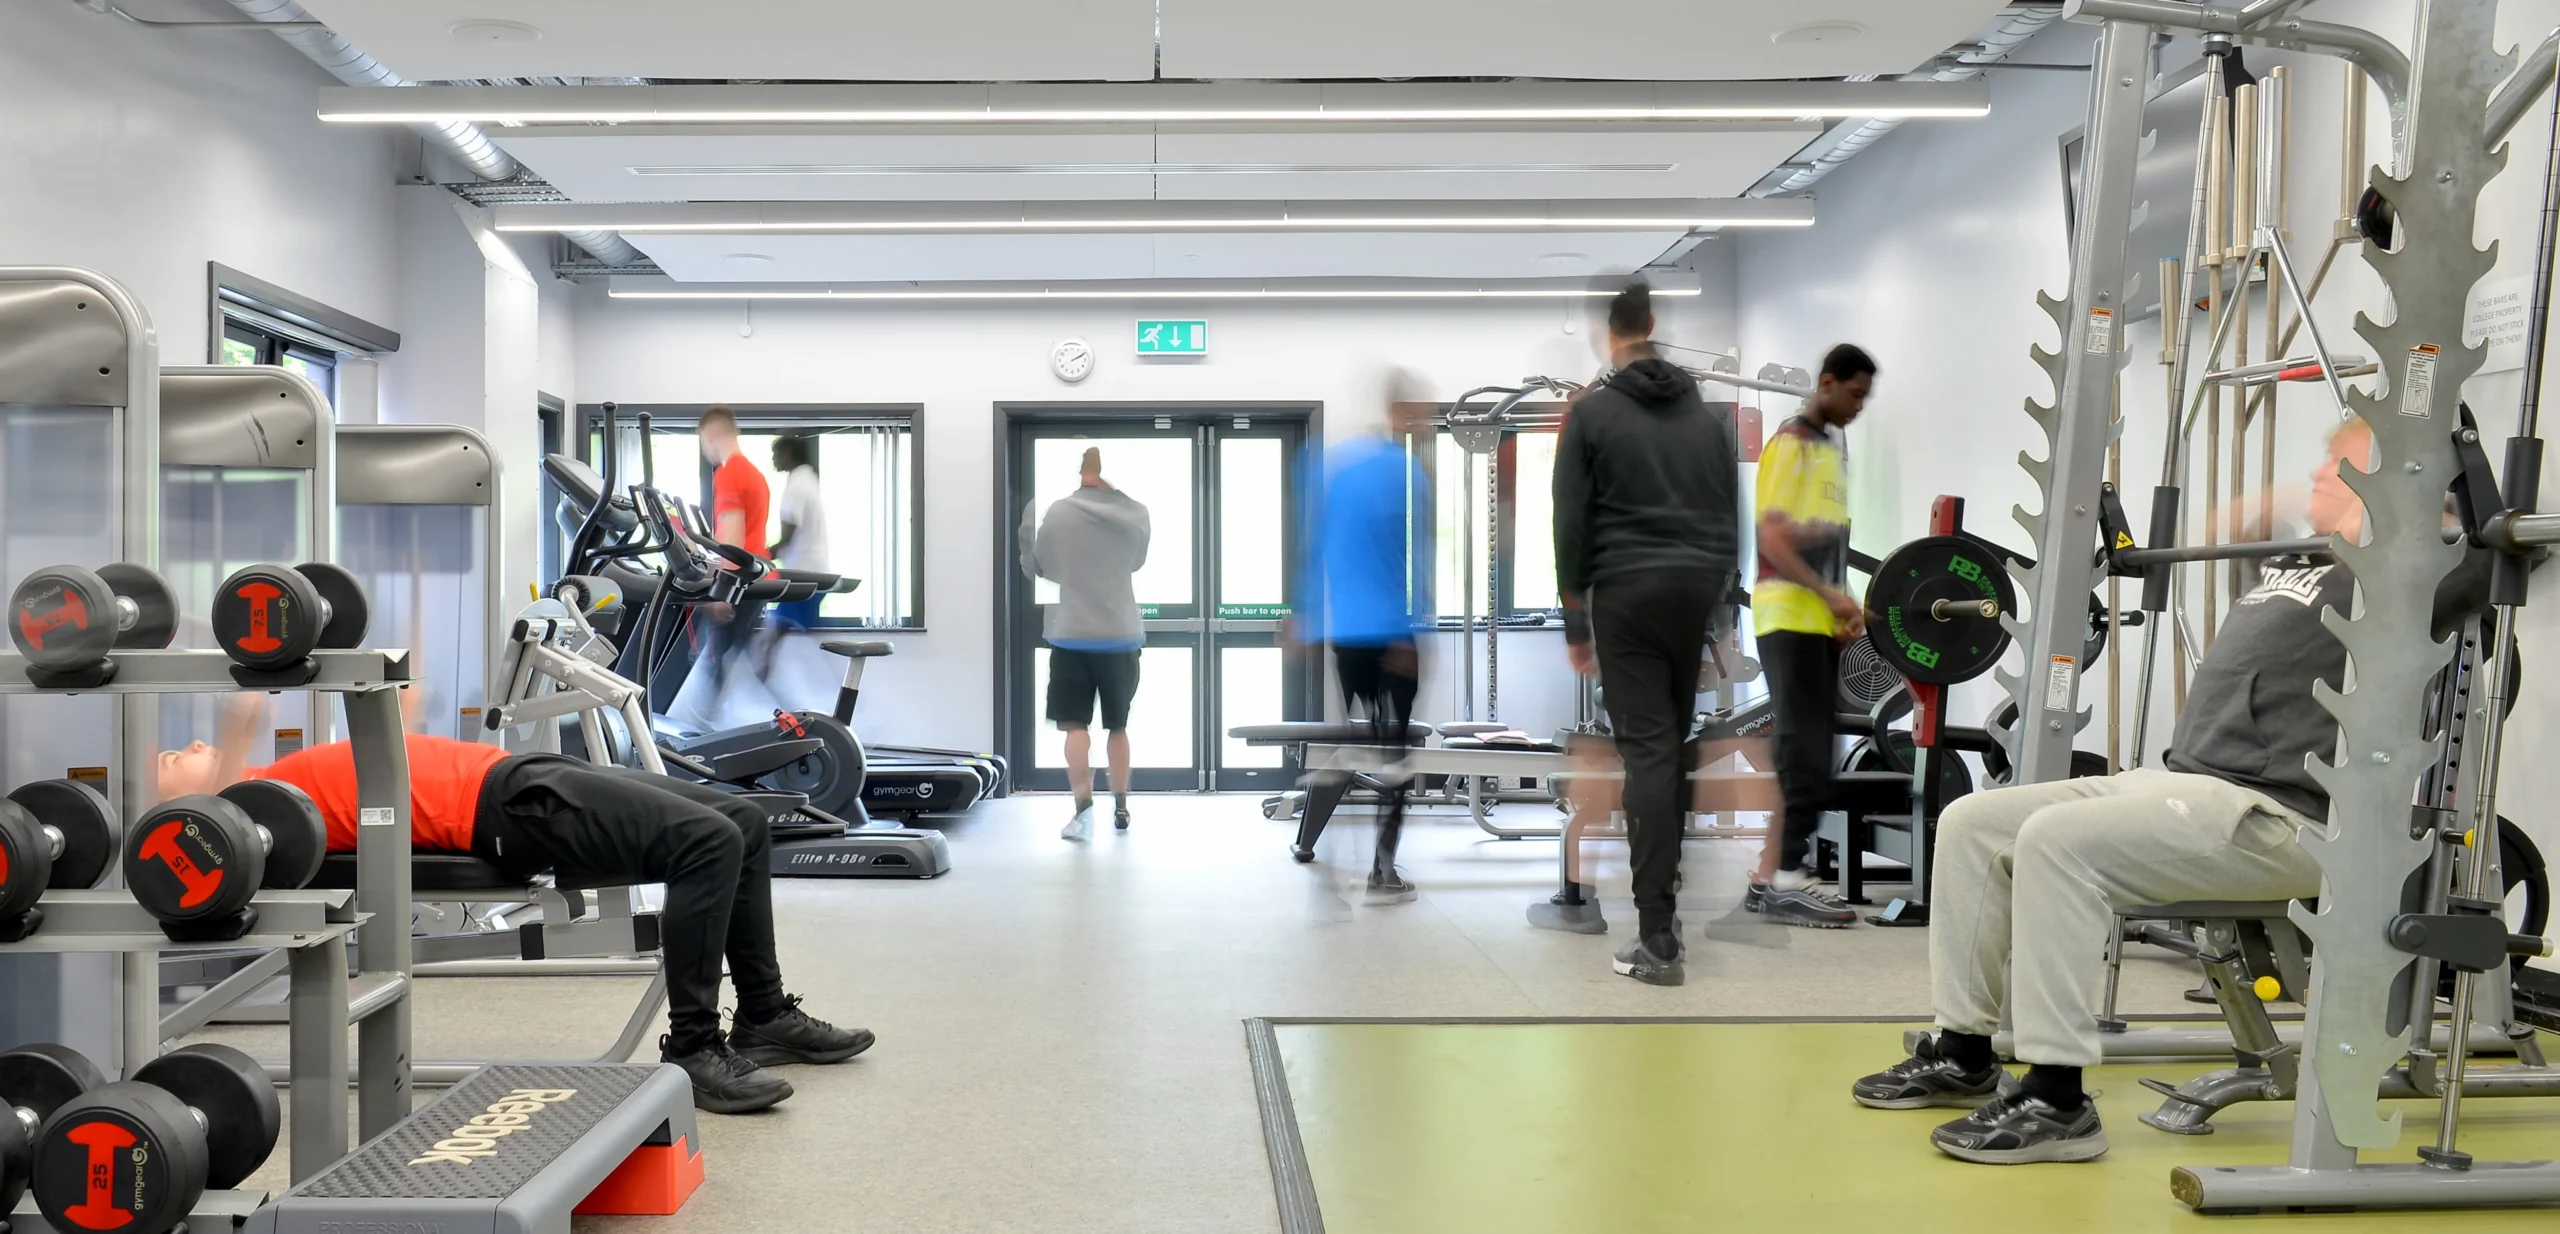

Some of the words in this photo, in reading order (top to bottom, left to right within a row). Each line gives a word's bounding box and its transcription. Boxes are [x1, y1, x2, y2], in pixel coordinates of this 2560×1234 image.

[2477, 298, 2492, 308] THESE
[2493, 295, 2507, 305] BARS
[2508, 292, 2519, 301] ARE
[2472, 311, 2494, 323] COLLEGE
[2495, 305, 2522, 318] PROPERTY
[2470, 327, 2488, 338] PLEASE
[2489, 325, 2497, 334] DO
[2497, 322, 2509, 332] NOT
[2509, 319, 2524, 330] STICK
[253, 608, 265, 627] 7.5
[1218, 606, 1241, 615] Push
[1242, 607, 1258, 615] bar
[1259, 607, 1269, 616] to
[1270, 608, 1292, 617] open
[281, 608, 289, 639] gymgear
[1735, 713, 1772, 737] gymgear
[873, 785, 915, 797] gymgear
[194, 834, 224, 865] gymgear
[790, 854, 823, 865] Elite
[825, 854, 866, 865] X-98e
[171, 855, 191, 876] 15
[407, 1089, 578, 1166] Reebok
[92, 1163, 108, 1190] 25
[134, 1165, 145, 1211] gymgear
